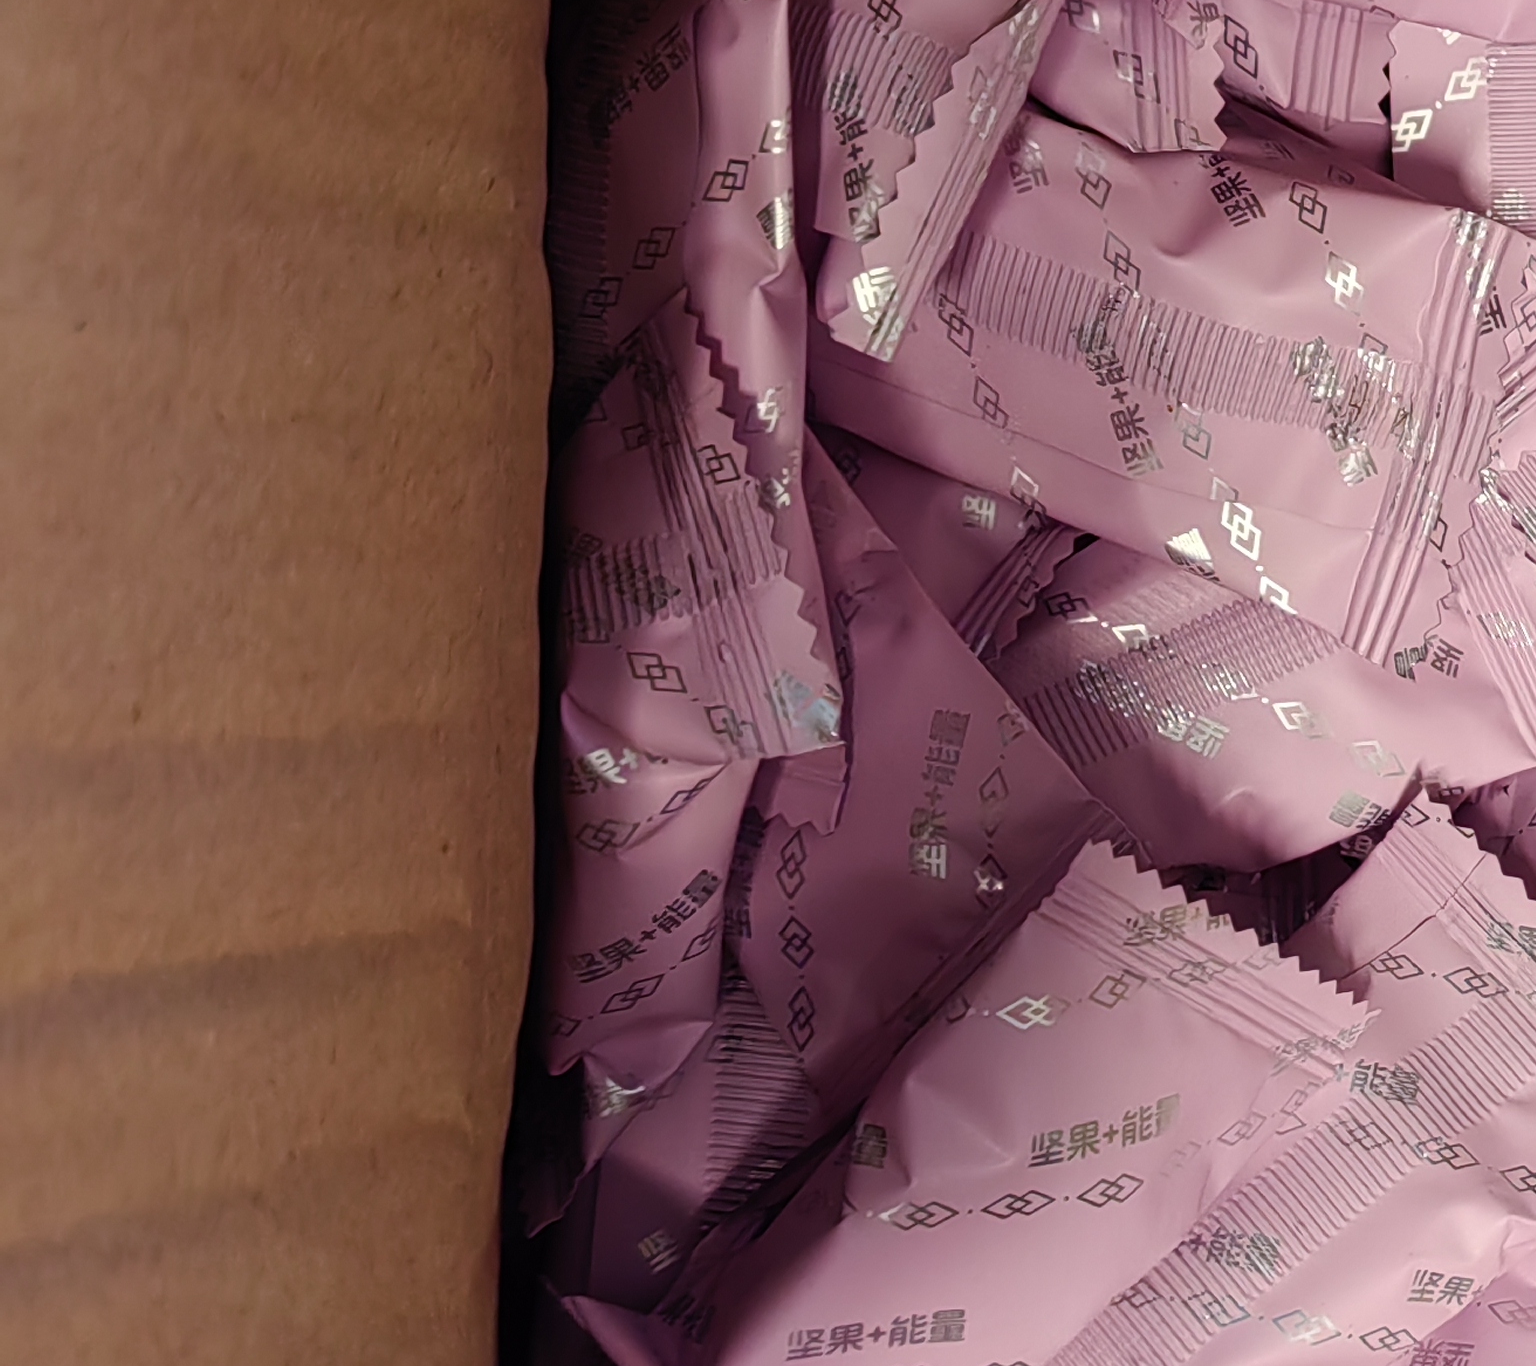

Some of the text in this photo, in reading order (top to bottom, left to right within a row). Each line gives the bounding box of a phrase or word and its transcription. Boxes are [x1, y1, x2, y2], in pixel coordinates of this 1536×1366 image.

[908, 708, 972, 881] 坚果+能量
[571, 868, 723, 985] 坚果+能量
[1027, 1092, 1182, 1170] 坚果+能量
[785, 1308, 967, 1362] 坚果+能量
